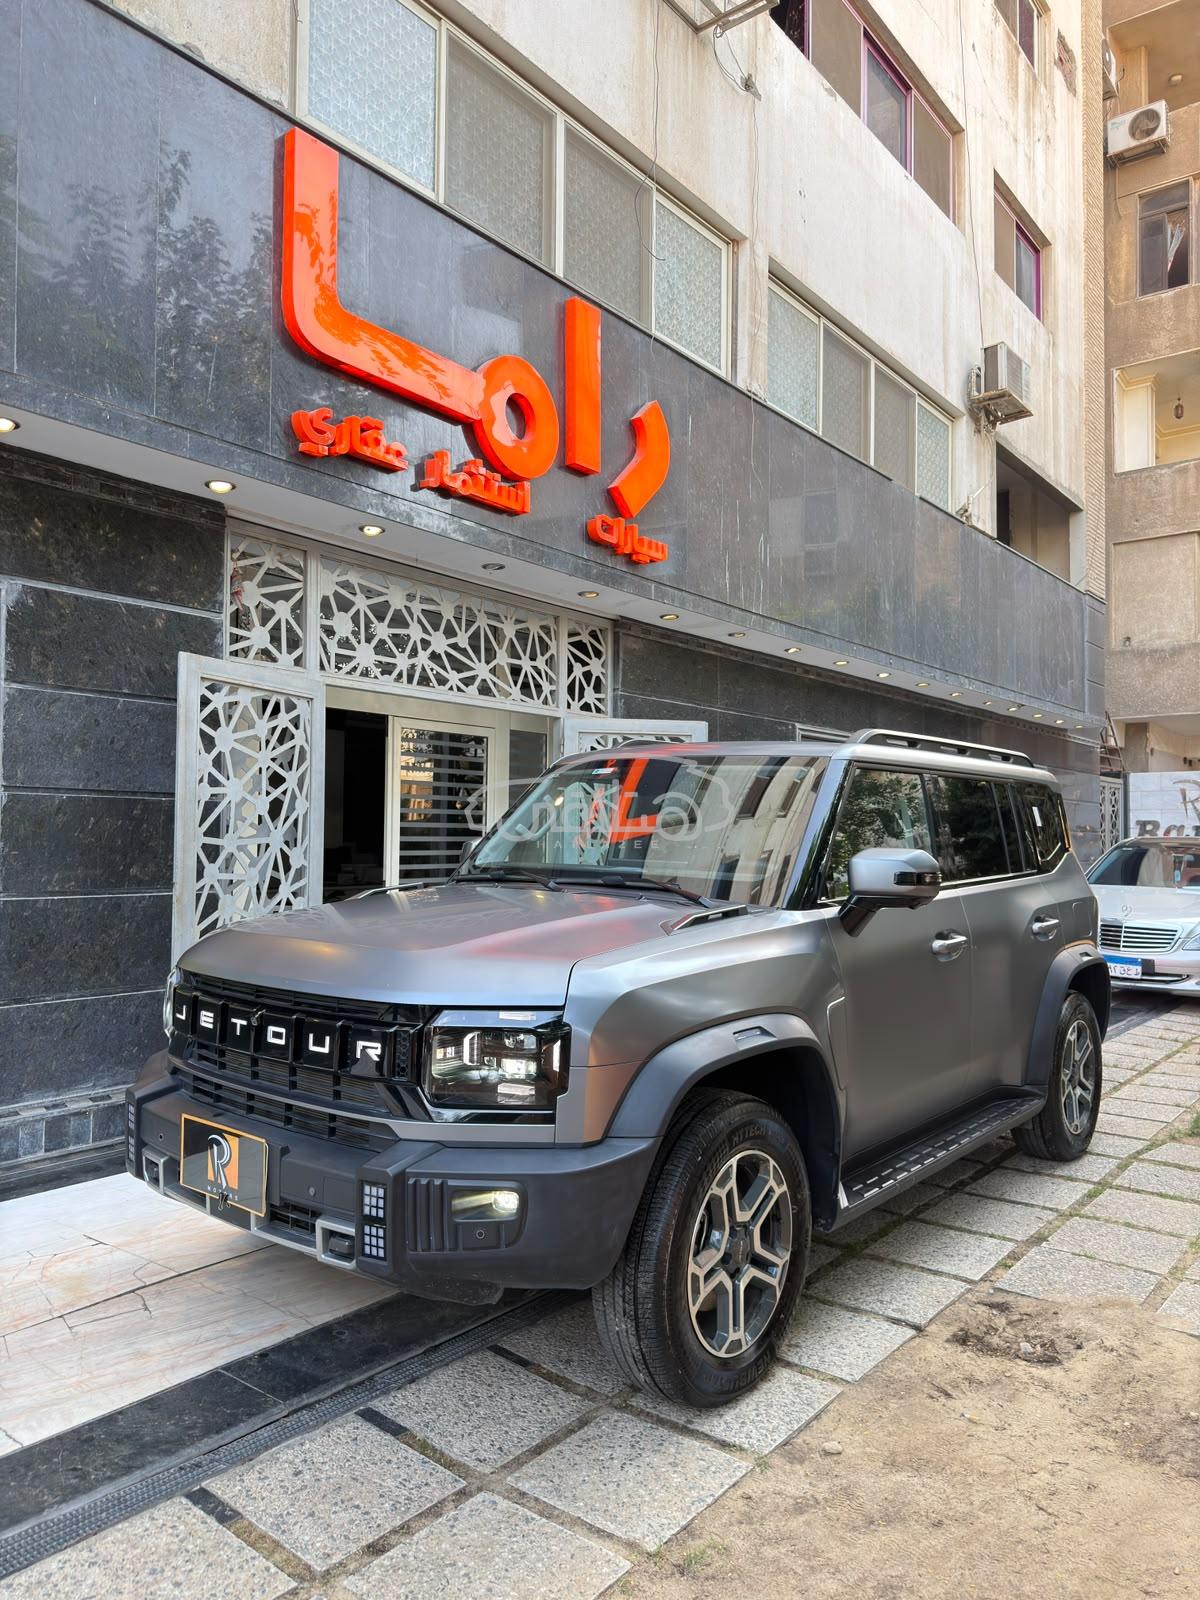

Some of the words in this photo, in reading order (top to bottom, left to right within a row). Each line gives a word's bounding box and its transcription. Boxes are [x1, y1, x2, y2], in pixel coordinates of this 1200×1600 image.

[280, 126, 671, 519] راما
[1135, 819, 1200, 837] Ra
[174, 1003, 383, 1062] JETOUR
